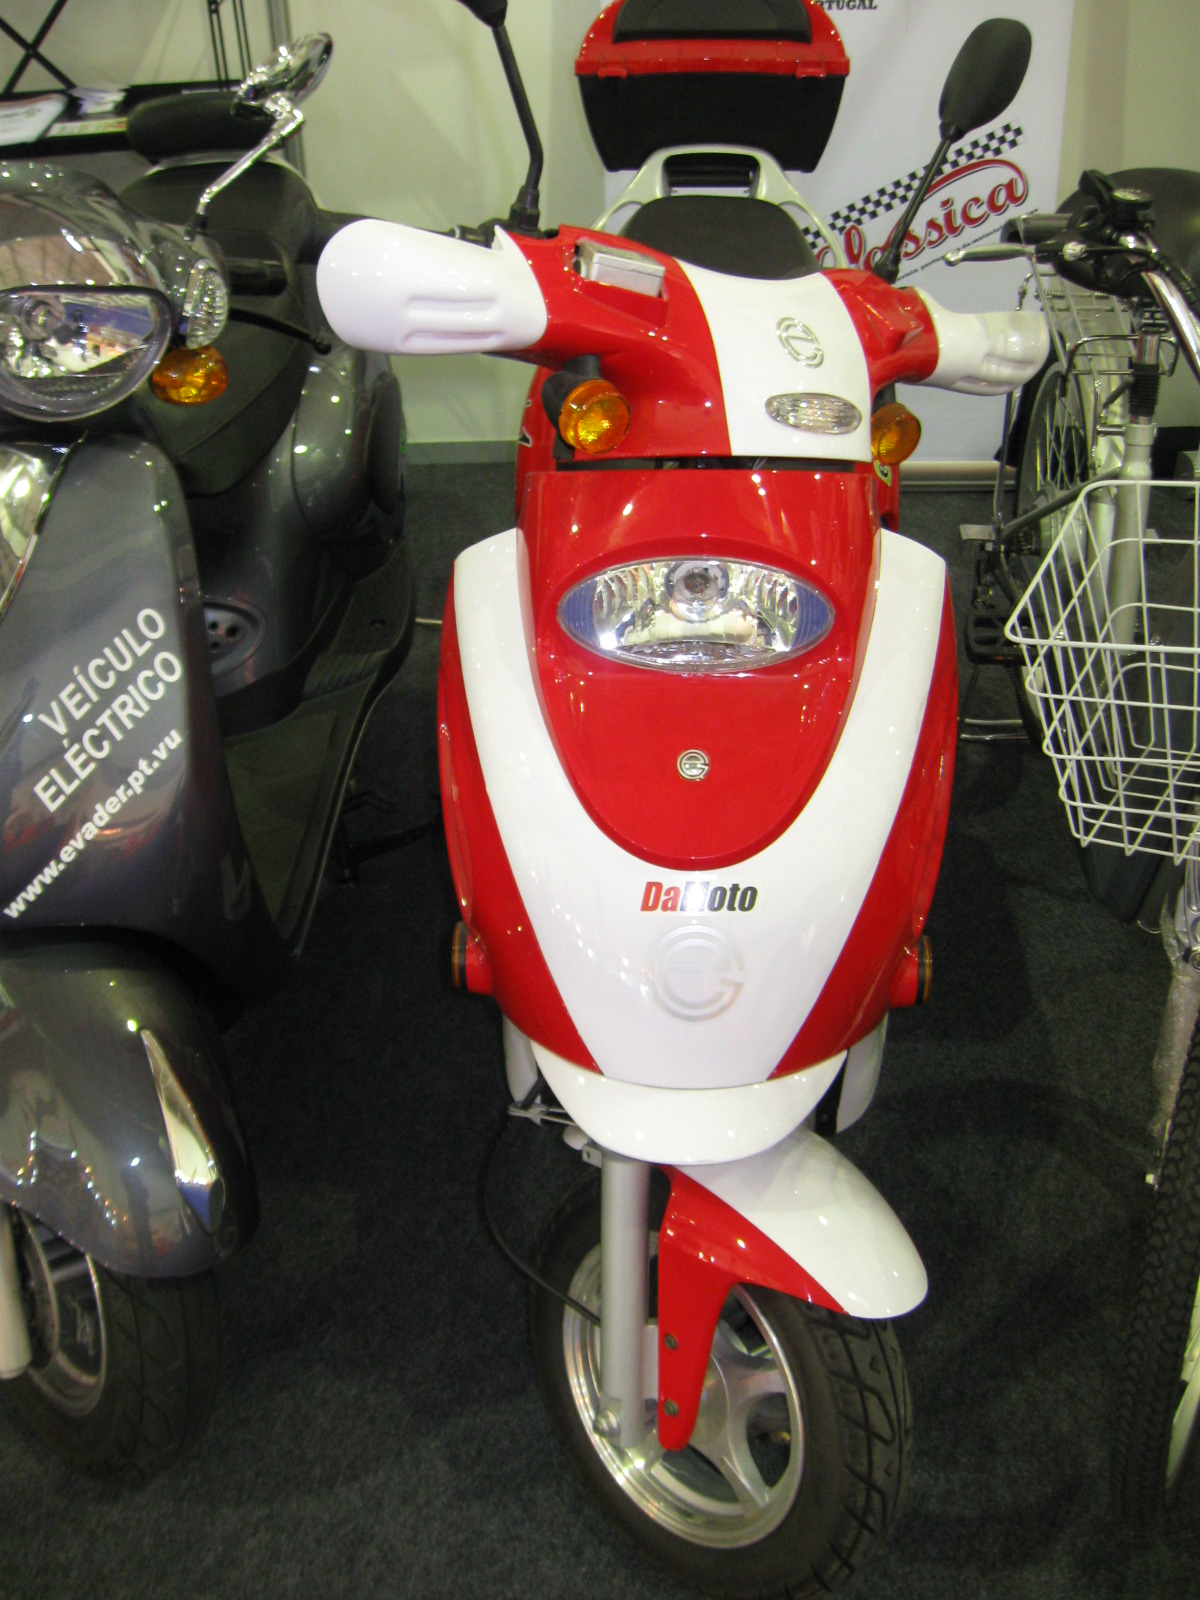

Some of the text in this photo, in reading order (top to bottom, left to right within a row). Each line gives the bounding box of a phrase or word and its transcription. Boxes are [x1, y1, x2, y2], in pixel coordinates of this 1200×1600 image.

[816, 158, 1028, 270] lassica
[33, 650, 183, 813] ELÉCTRICO
[37, 607, 166, 736] VEÍCULO
[3, 729, 183, 919] www.evader.pt.vu
